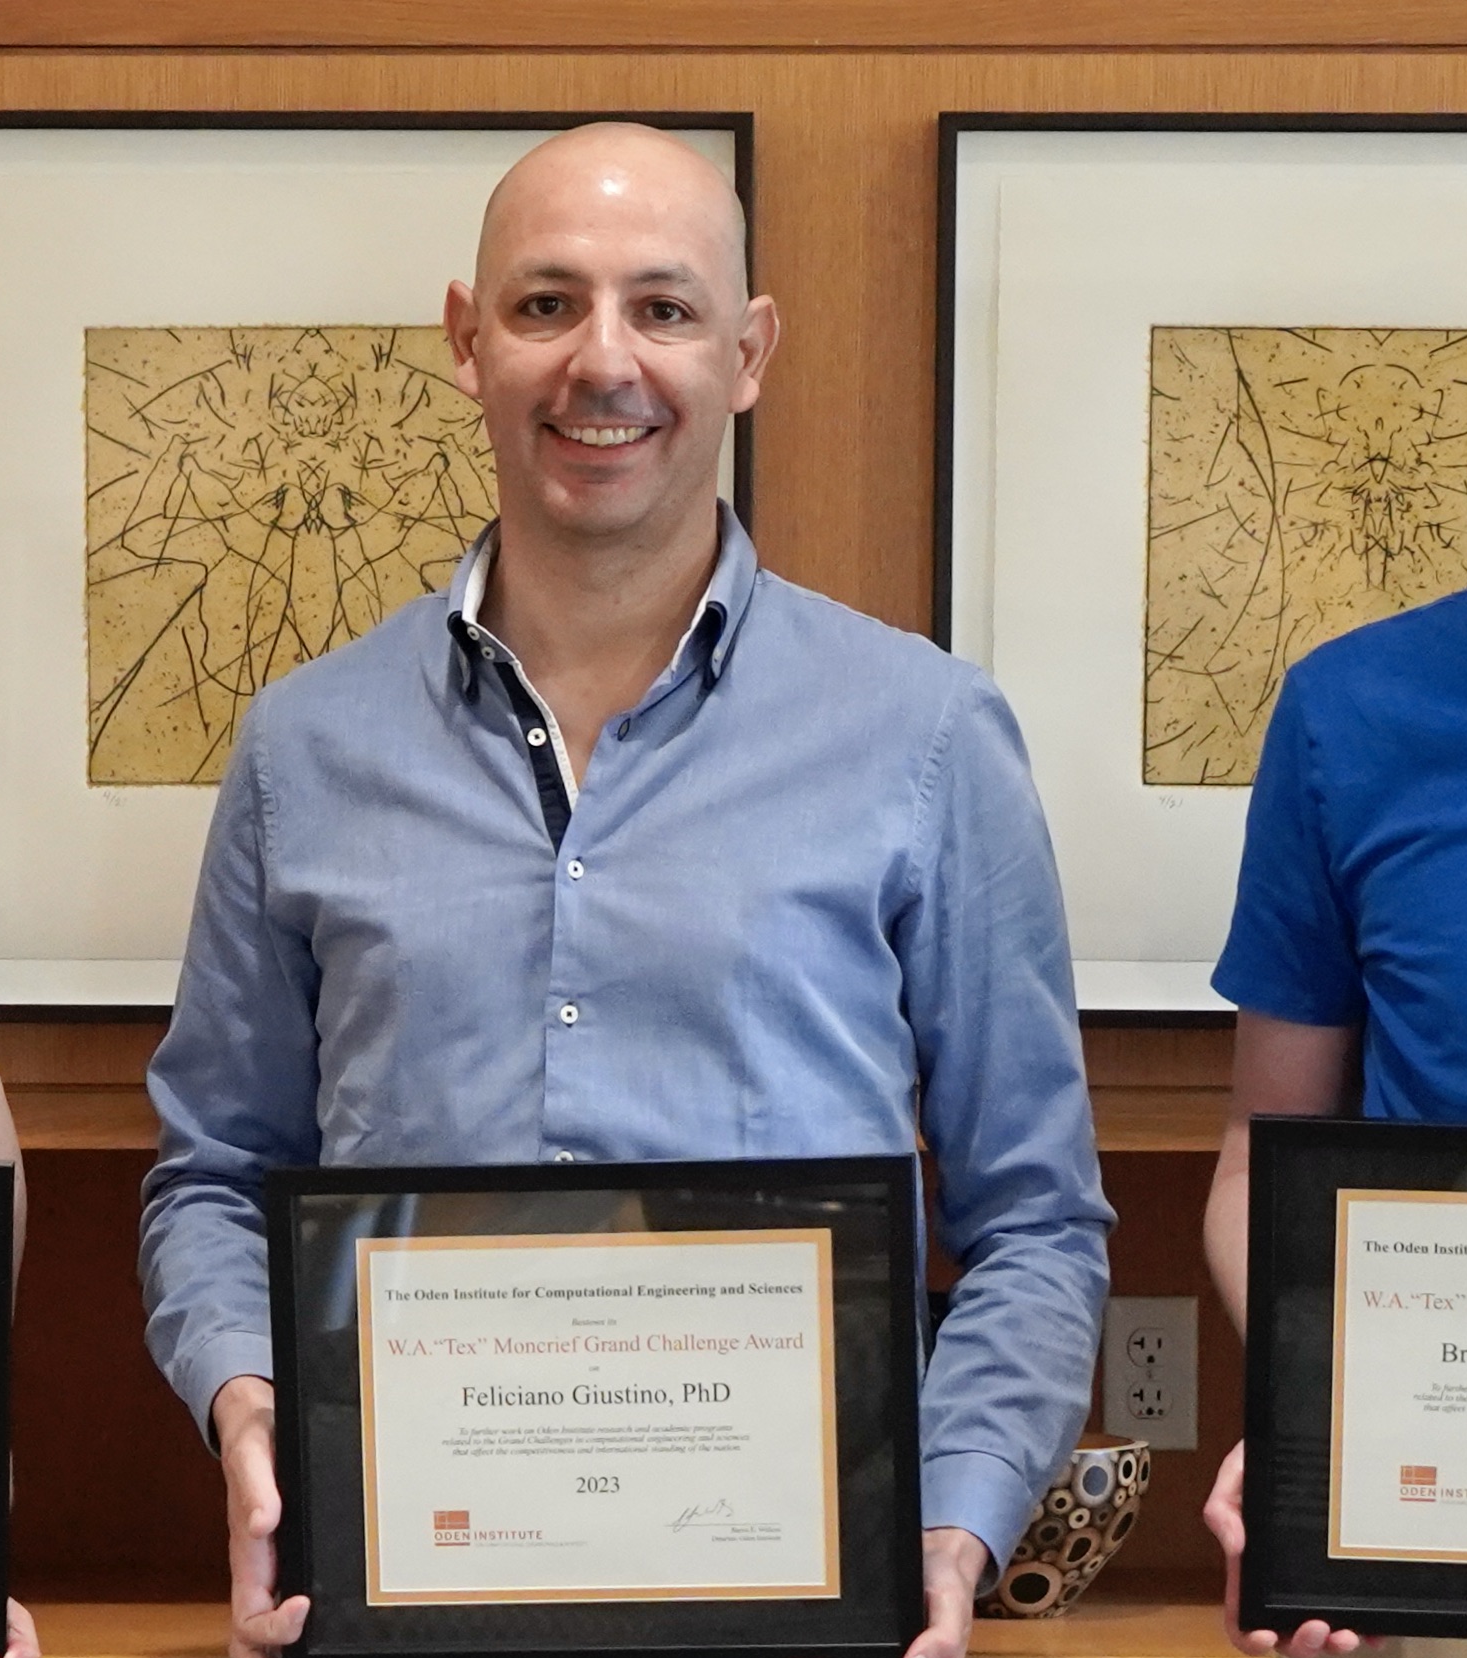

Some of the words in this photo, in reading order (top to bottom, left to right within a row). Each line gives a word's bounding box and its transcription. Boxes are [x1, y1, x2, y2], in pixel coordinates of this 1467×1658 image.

[1363, 1240, 1389, 1253] The
[1392, 1241, 1429, 1254] Oden
[384, 1289, 410, 1301] The
[413, 1288, 449, 1300] Oden
[453, 1287, 507, 1300] Institute
[511, 1286, 531, 1298] for
[534, 1285, 632, 1300] Computational
[636, 1284, 716, 1298] Engineering
[719, 1283, 745, 1295] and
[748, 1282, 802, 1294] Sciences
[494, 1335, 580, 1354] Moncrief
[583, 1334, 640, 1352] Grand
[646, 1333, 739, 1355] Challenge
[744, 1331, 803, 1349] Award
[462, 1385, 564, 1406] Feliciano
[571, 1383, 673, 1405] Giustino,
[682, 1382, 730, 1402] PhD
[576, 1475, 620, 1493] 2023
[1399, 1485, 1436, 1499] ODEN
[433, 1530, 470, 1543] ODEN
[473, 1529, 542, 1540] INSTITUTE
